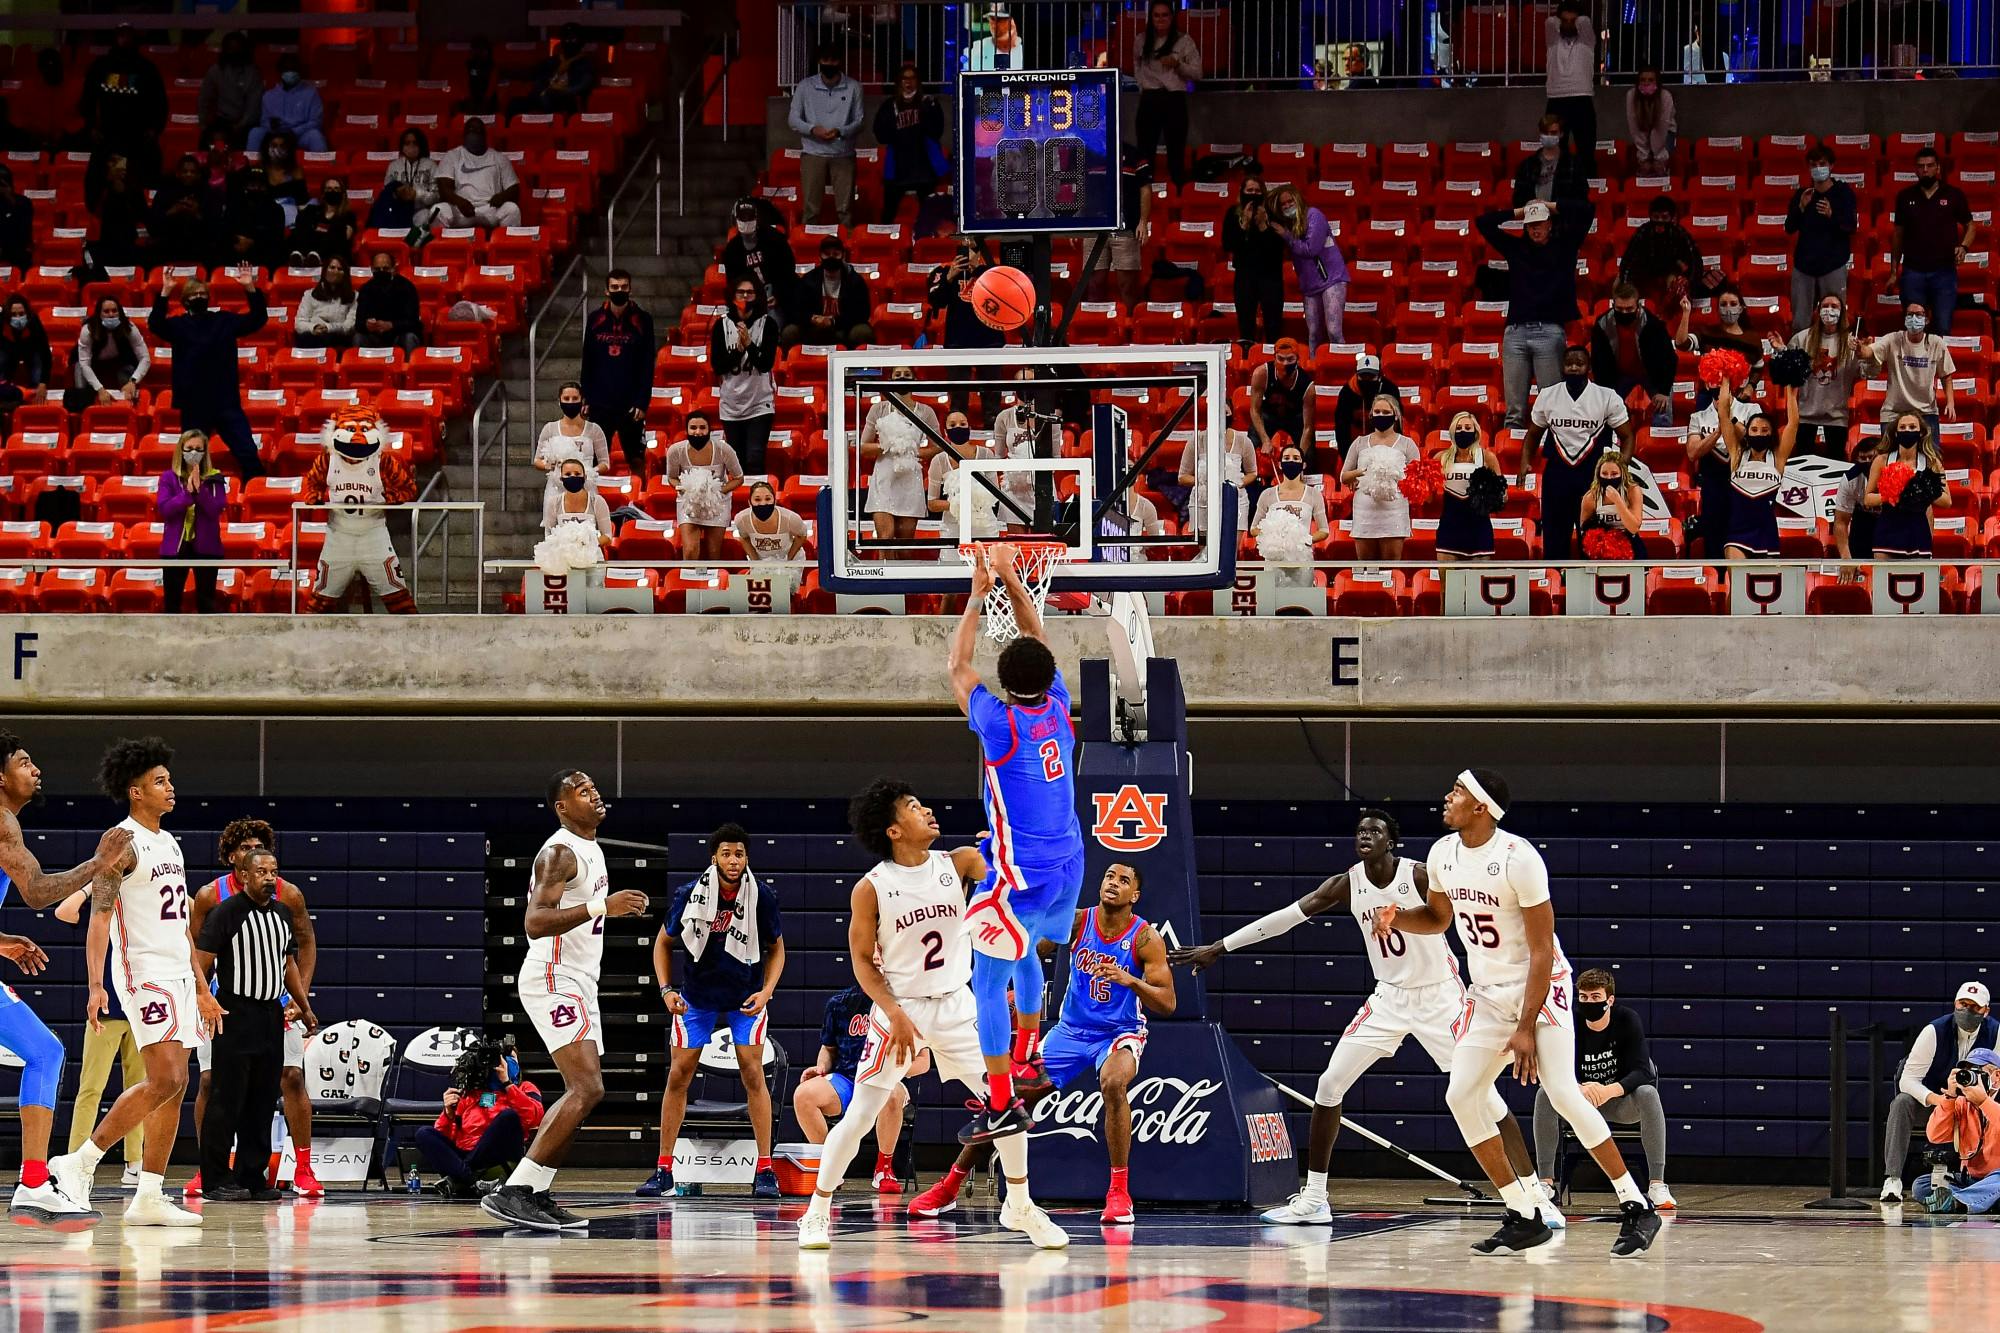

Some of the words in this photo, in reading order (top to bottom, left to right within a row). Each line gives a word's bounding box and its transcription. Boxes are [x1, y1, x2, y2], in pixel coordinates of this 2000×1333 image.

[1001, 73, 1076, 82] DAKTRONICS
[1549, 418, 1600, 429] AUBURN
[335, 482, 373, 494] AUBURN
[1733, 471, 1780, 483] AUBURN
[846, 567, 884, 577] SPALDING
[14, 632, 38, 680] F
[1331, 637, 1359, 686] E
[1039, 738, 1065, 782] 2
[159, 884, 187, 920] 22
[895, 904, 958, 934] AUBURN
[1459, 912, 1500, 949] 35
[920, 930, 945, 972] 2
[1379, 929, 1406, 959] 10
[1090, 979, 1111, 1003] 15
[1581, 1059, 1618, 1071] HISTORY
[1584, 1050, 1613, 1062] BLACK
[1584, 1068, 1618, 1080] MONTH
[1028, 1089, 1104, 1142] oca
[1245, 1112, 1293, 1163] AUBURN
[284, 1153, 367, 1164] NSSAN
[671, 1154, 755, 1167] NISSAN
